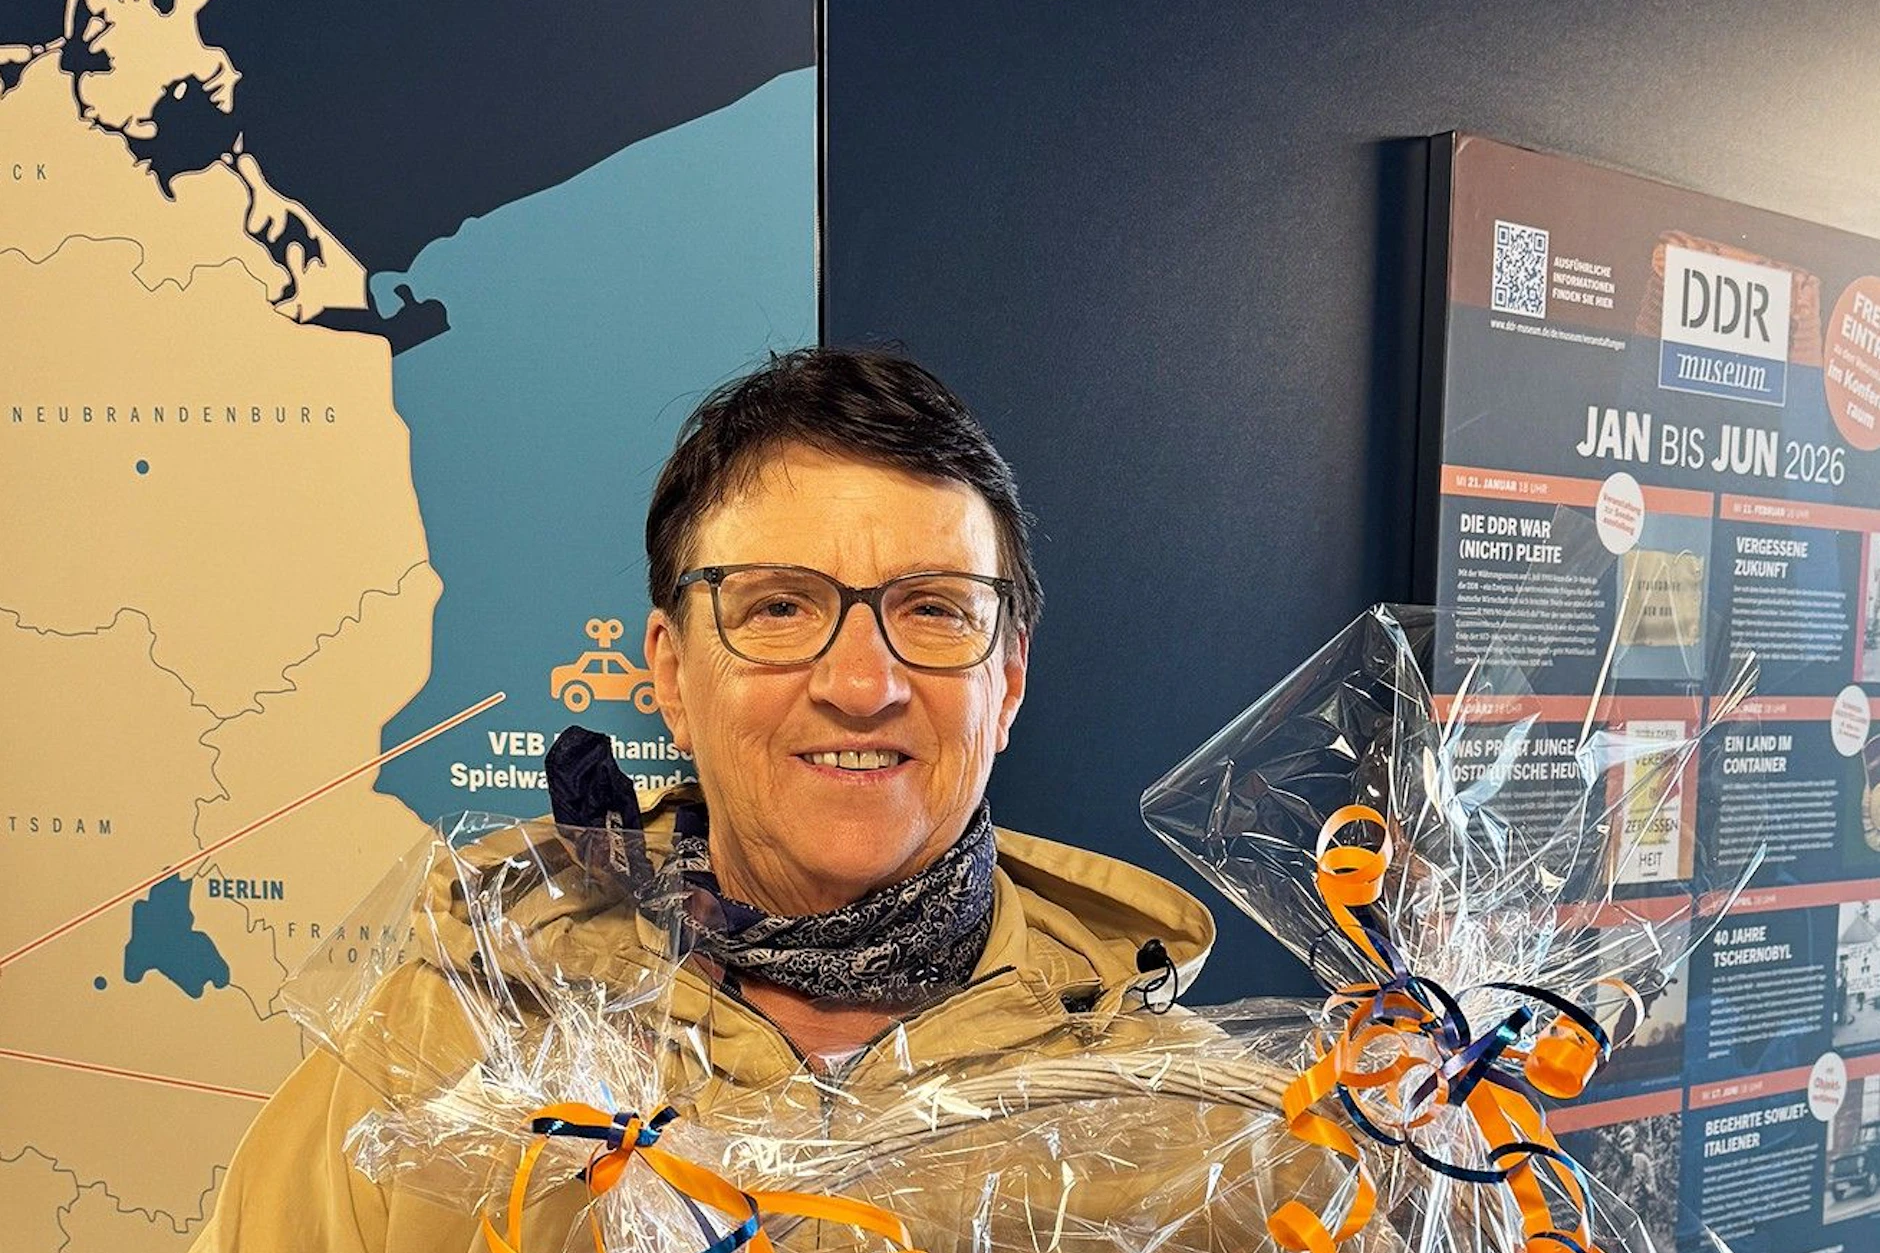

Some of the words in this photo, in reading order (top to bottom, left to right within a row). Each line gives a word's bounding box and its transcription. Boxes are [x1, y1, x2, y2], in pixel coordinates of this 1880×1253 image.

[1681, 268, 1770, 342] DDR
[1677, 352, 1771, 392] museum
[12, 406, 336, 424] NEUBRANDENBURG
[1576, 406, 1651, 463] JAN
[1660, 424, 1705, 470] BIS
[1711, 425, 1778, 477] JUN
[1783, 441, 1845, 485] 2026
[1460, 513, 1485, 534] DIE
[1487, 516, 1518, 537] DDR
[1520, 519, 1551, 539] WAR
[1459, 538, 1513, 563] (NICHT)
[1516, 544, 1563, 565] PLEITE
[1736, 535, 1809, 558] VERGESSENE
[1734, 559, 1788, 579] ZUKUNFT
[488, 731, 545, 757] VEB
[1532, 738, 1576, 756] JUNGE
[1725, 736, 1744, 752] EIN
[1746, 735, 1777, 753] LAND
[1778, 735, 1792, 751] IM
[450, 763, 548, 792] Spielwa
[1723, 757, 1787, 775] CONTAINER
[209, 878, 284, 900] BERLIN
[288, 921, 415, 942] FRANKF
[1713, 929, 1729, 946] 40
[1730, 925, 1767, 945] JAHRE
[1712, 943, 1793, 968] TSCHERNOBYL
[1705, 1109, 1763, 1137] BEGEHRTE
[1763, 1102, 1809, 1126] SOWJET-
[1704, 1132, 1761, 1158] ITALIENER
